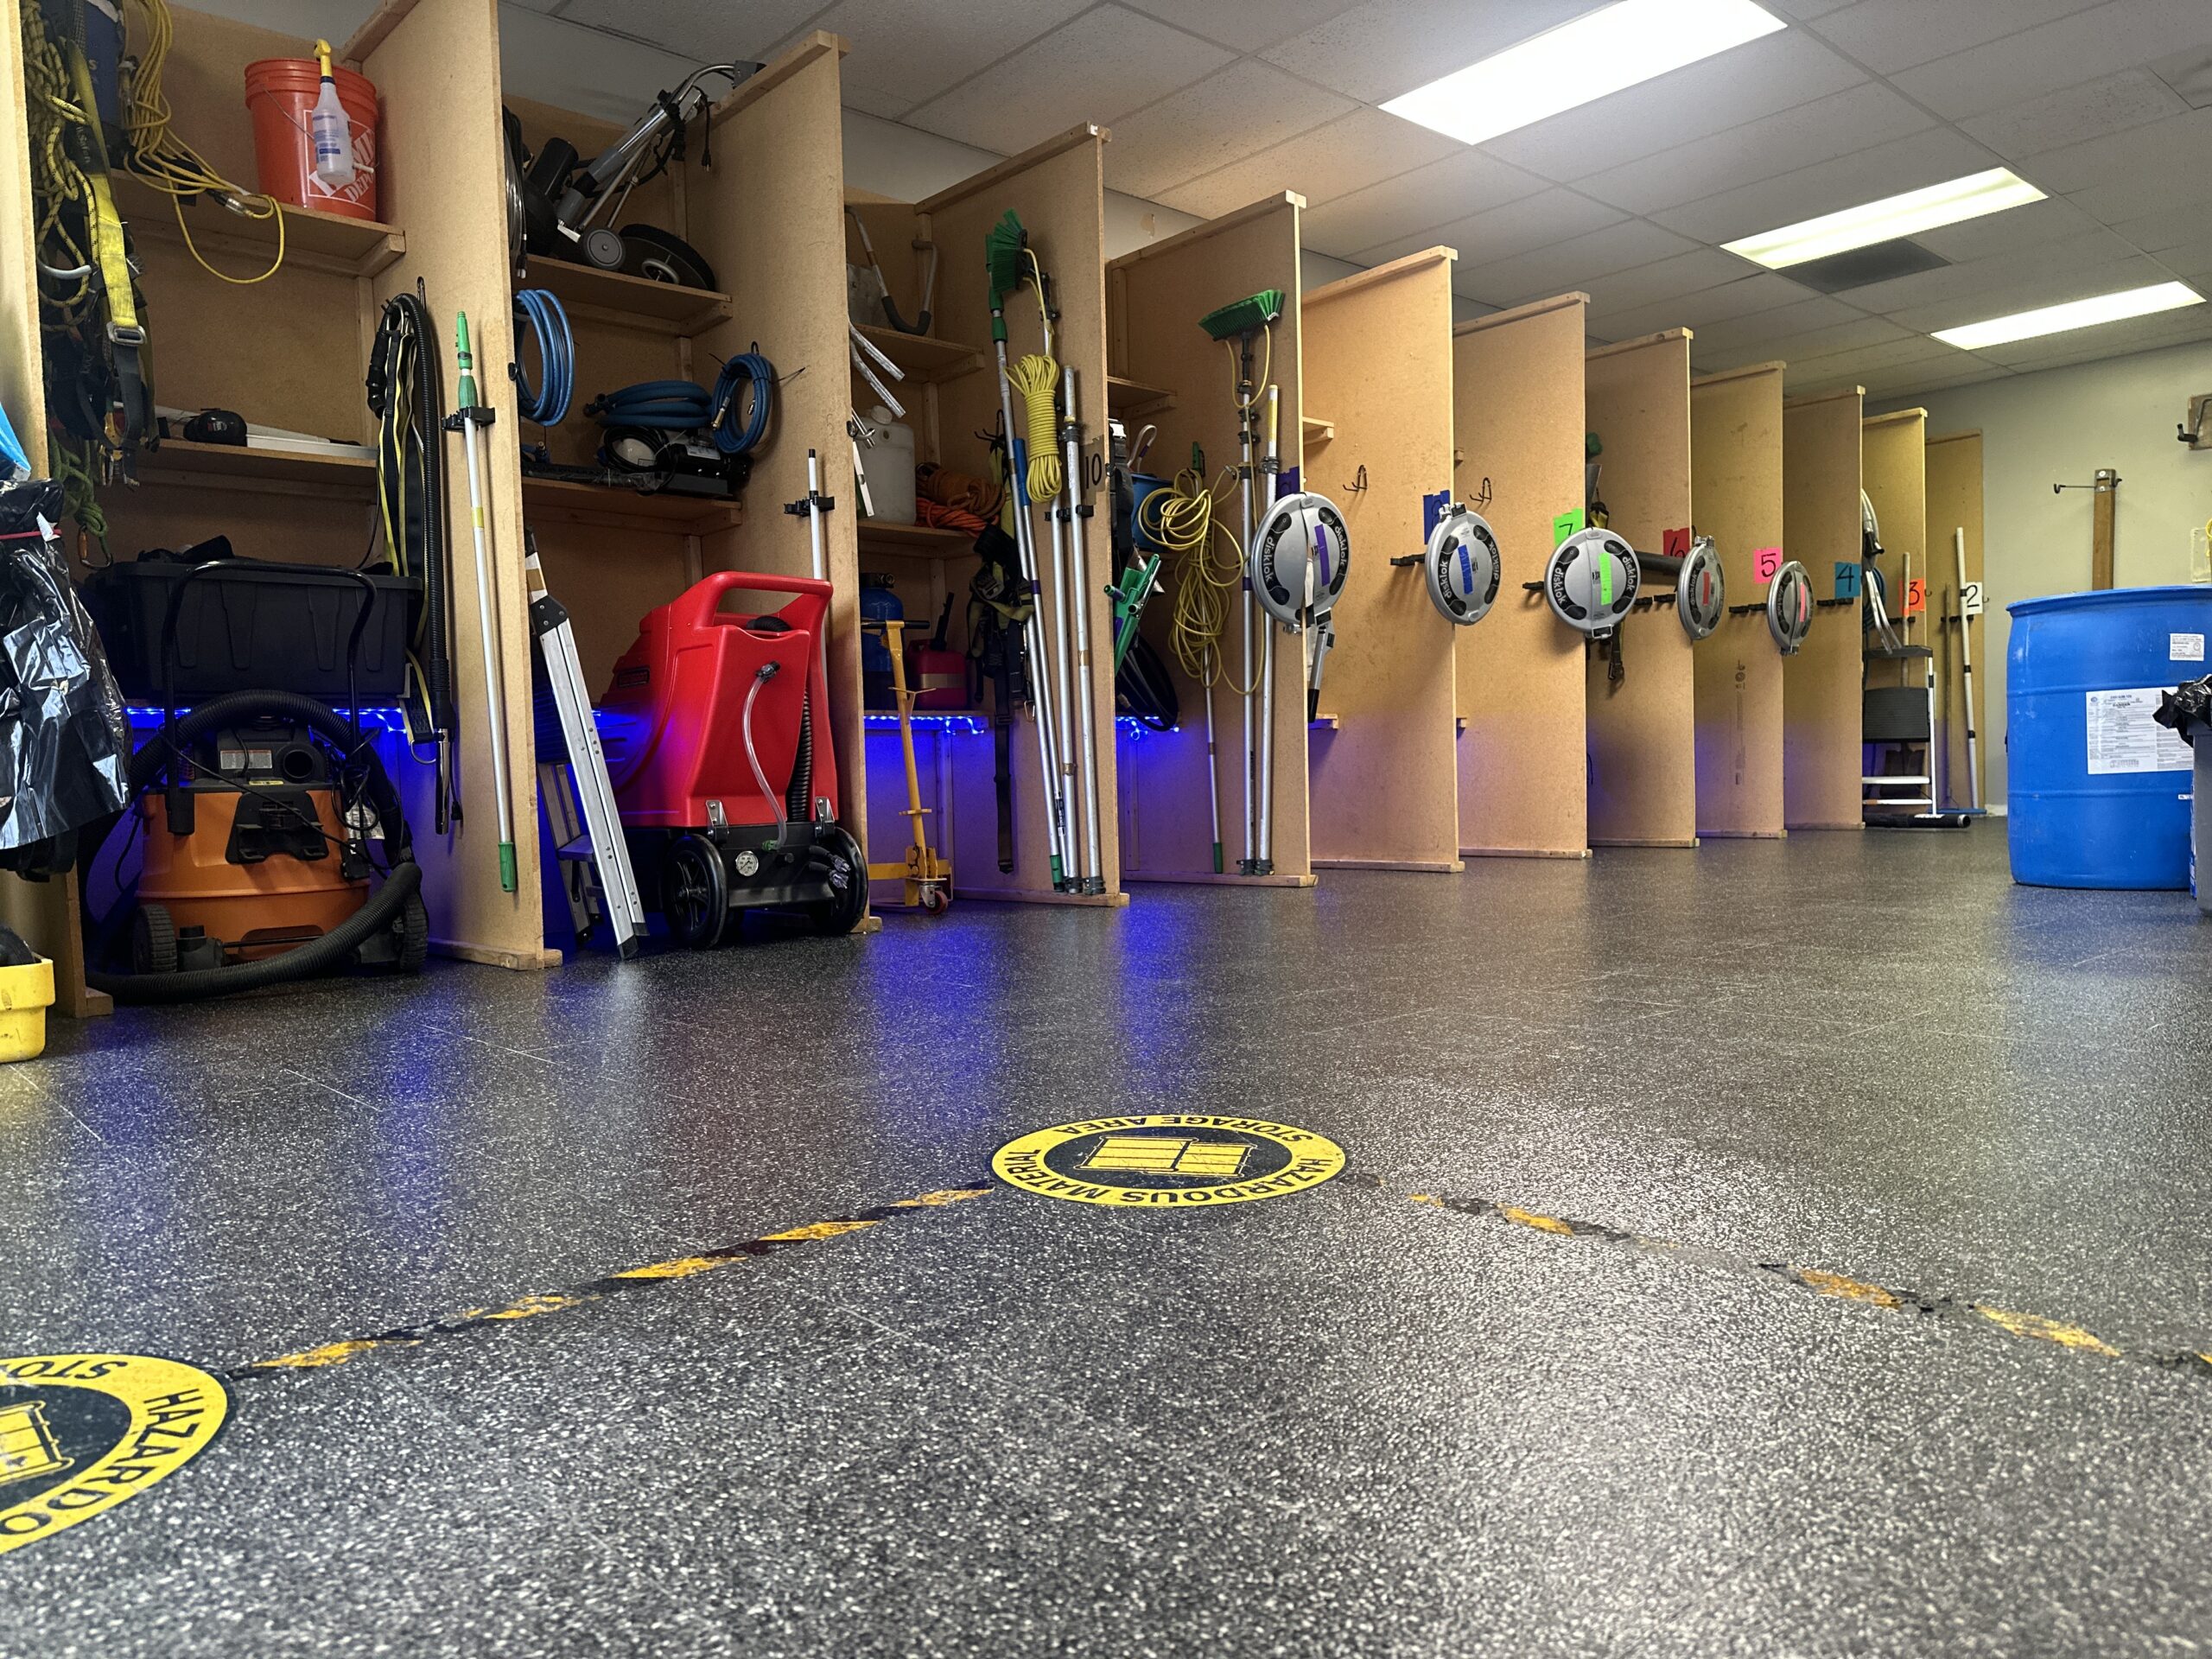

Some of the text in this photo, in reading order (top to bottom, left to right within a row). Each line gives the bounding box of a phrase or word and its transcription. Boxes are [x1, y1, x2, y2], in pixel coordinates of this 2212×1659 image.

[1085, 453, 1102, 489] 10
[1332, 525, 1347, 566] disklok
[1559, 523, 1573, 536] 7
[1263, 534, 1274, 582] disklok
[1489, 540, 1499, 581] disklok
[1669, 537, 1686, 558] 6
[1439, 560, 1452, 600] disklok
[1622, 556, 1636, 591] disklok
[1761, 553, 1777, 578] 5
[1836, 564, 1854, 592] 4
[1554, 567, 1567, 605] disklok
[1909, 582, 1920, 606] 3
[1966, 584, 1980, 608] 2
[1052, 1116, 1313, 1141] STORAGE AREA
[1003, 1149, 1325, 1205] HAZARDOUS MATERIAL
[0, 1360, 128, 1380] STO
[0, 1389, 205, 1535] HAZARDO
